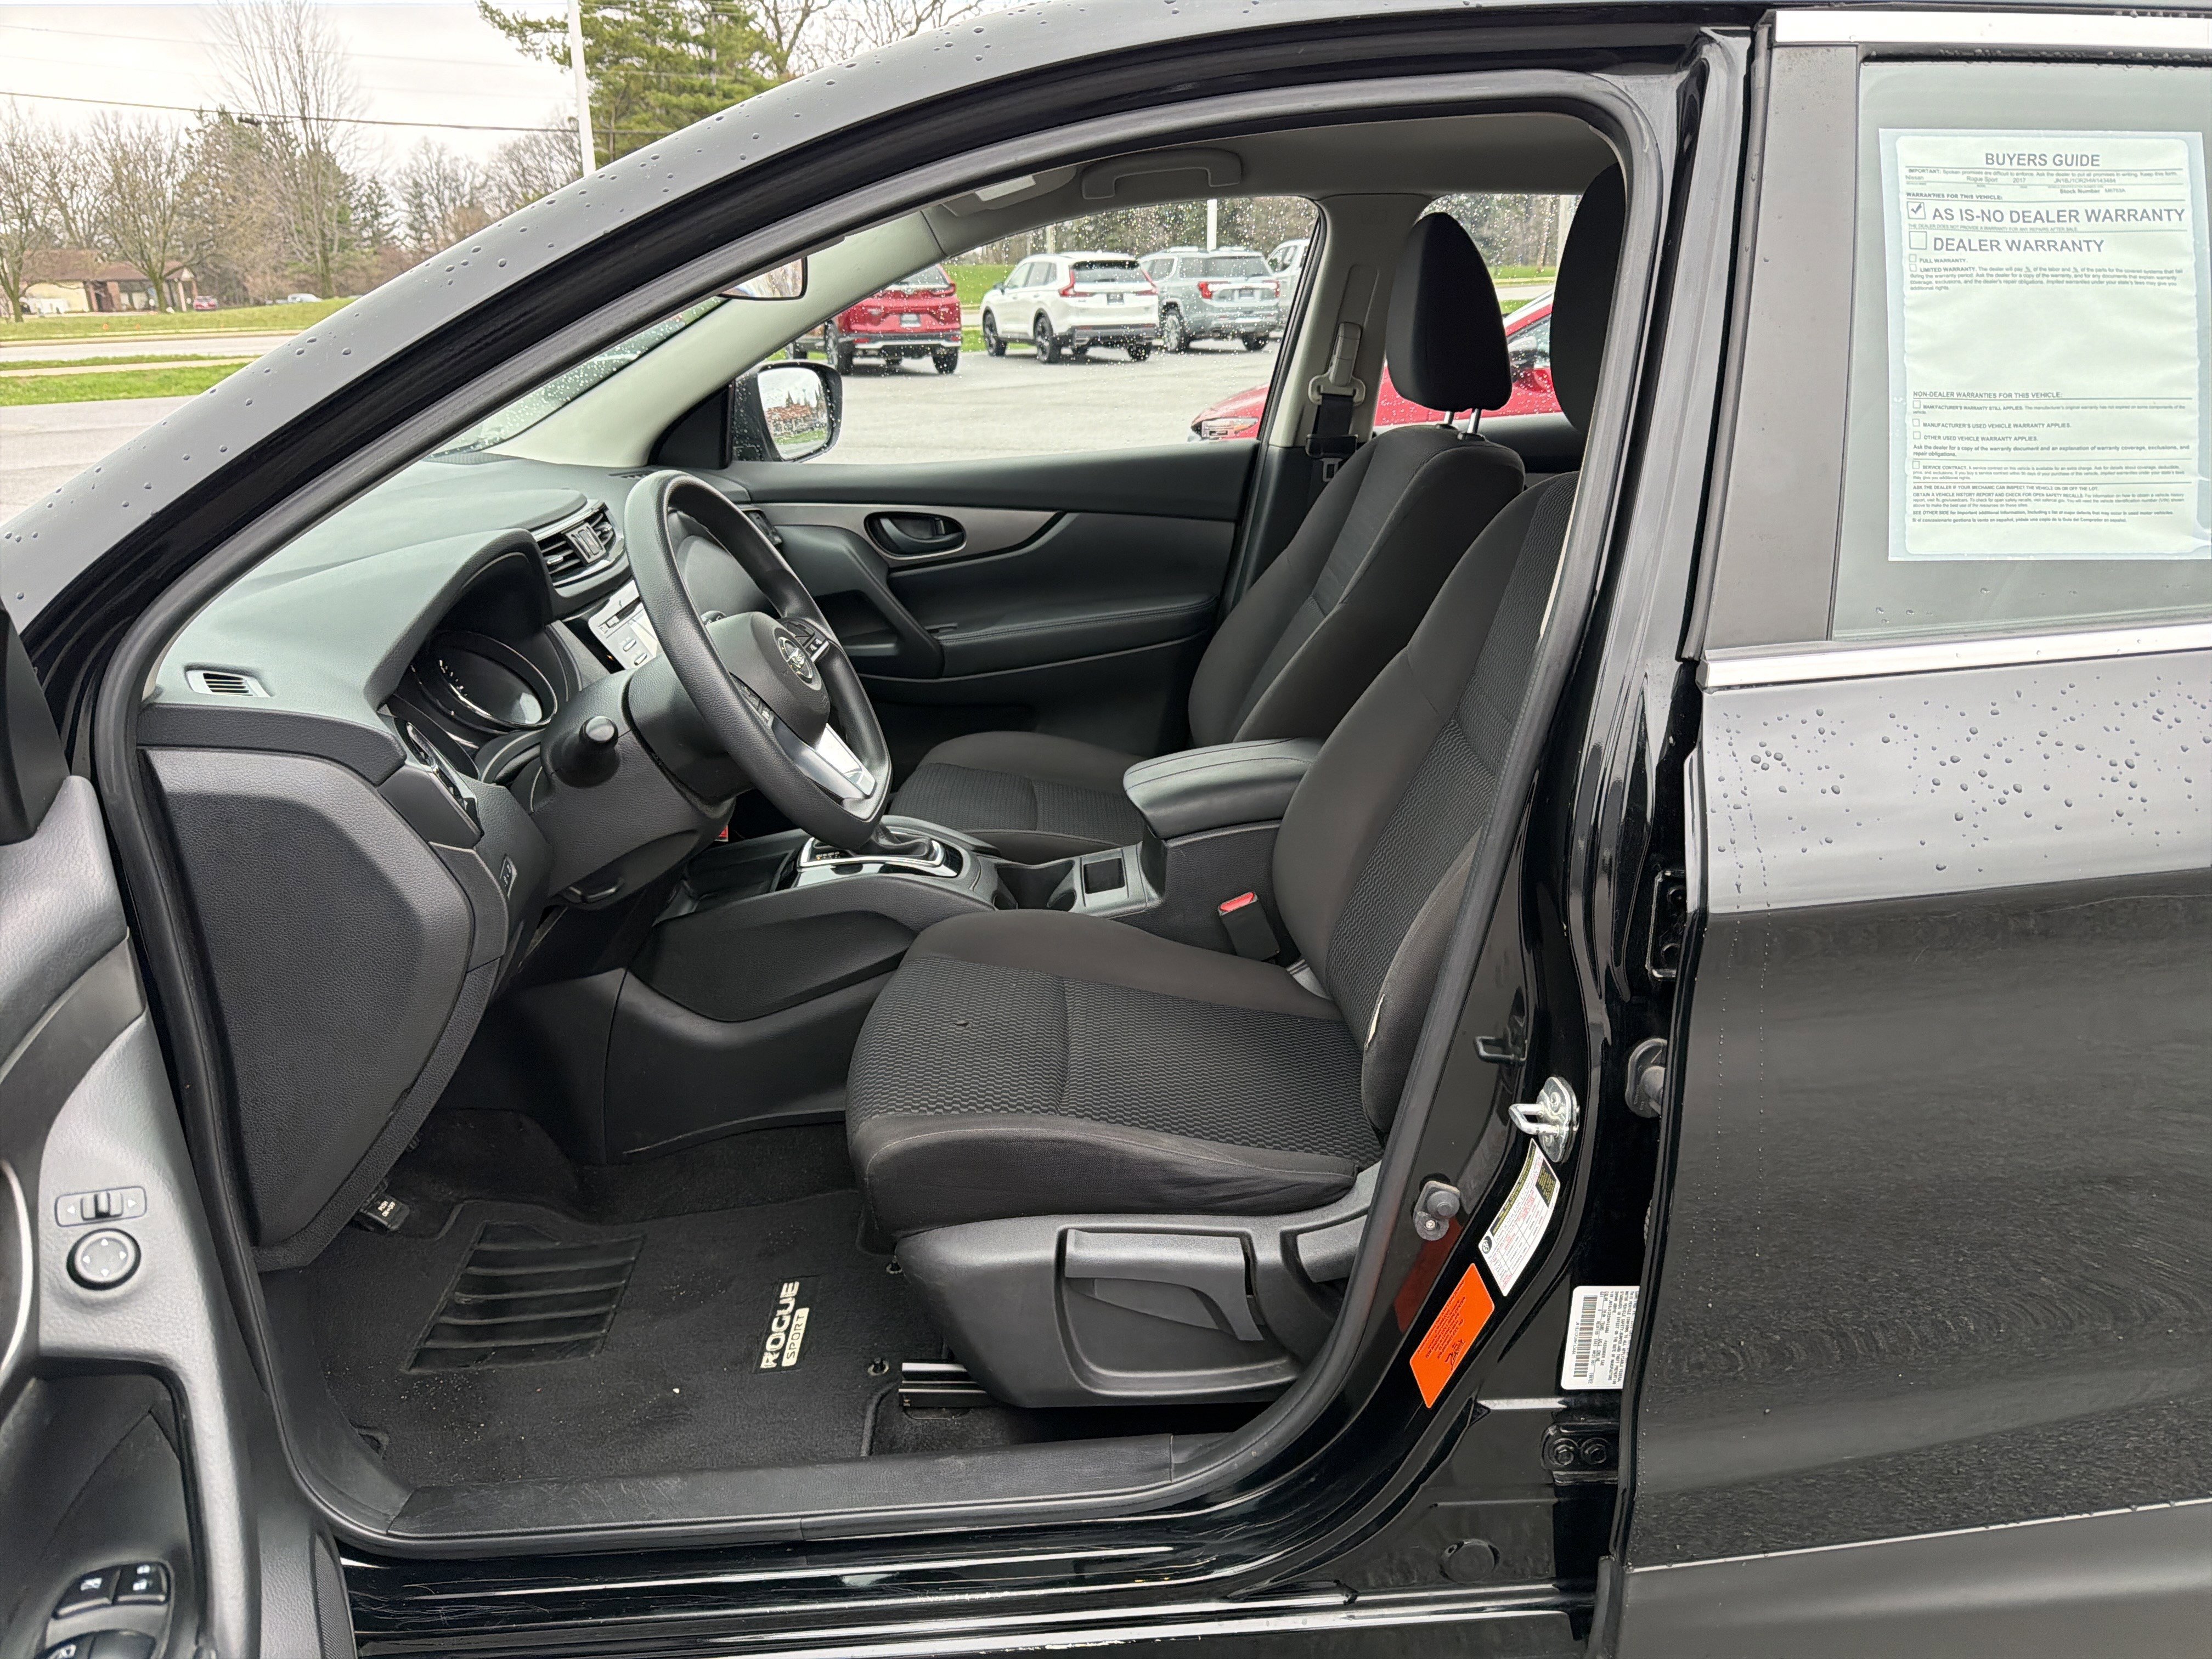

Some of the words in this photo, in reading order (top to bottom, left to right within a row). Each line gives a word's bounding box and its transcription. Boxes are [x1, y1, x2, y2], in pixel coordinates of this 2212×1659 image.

[1985, 153, 2047, 167] BUYERS
[2053, 154, 2100, 167] GUIDE
[1932, 208, 1955, 221] AS
[1960, 208, 2004, 223] IS-NO
[2010, 209, 2080, 224] DEALER
[2085, 208, 2185, 223] WARRANTY
[1934, 237, 2002, 252] DEALER
[2005, 239, 2104, 252] WARRANTY
[760, 1282, 799, 1368] ROGUE
[786, 1314, 805, 1359] SPORT
